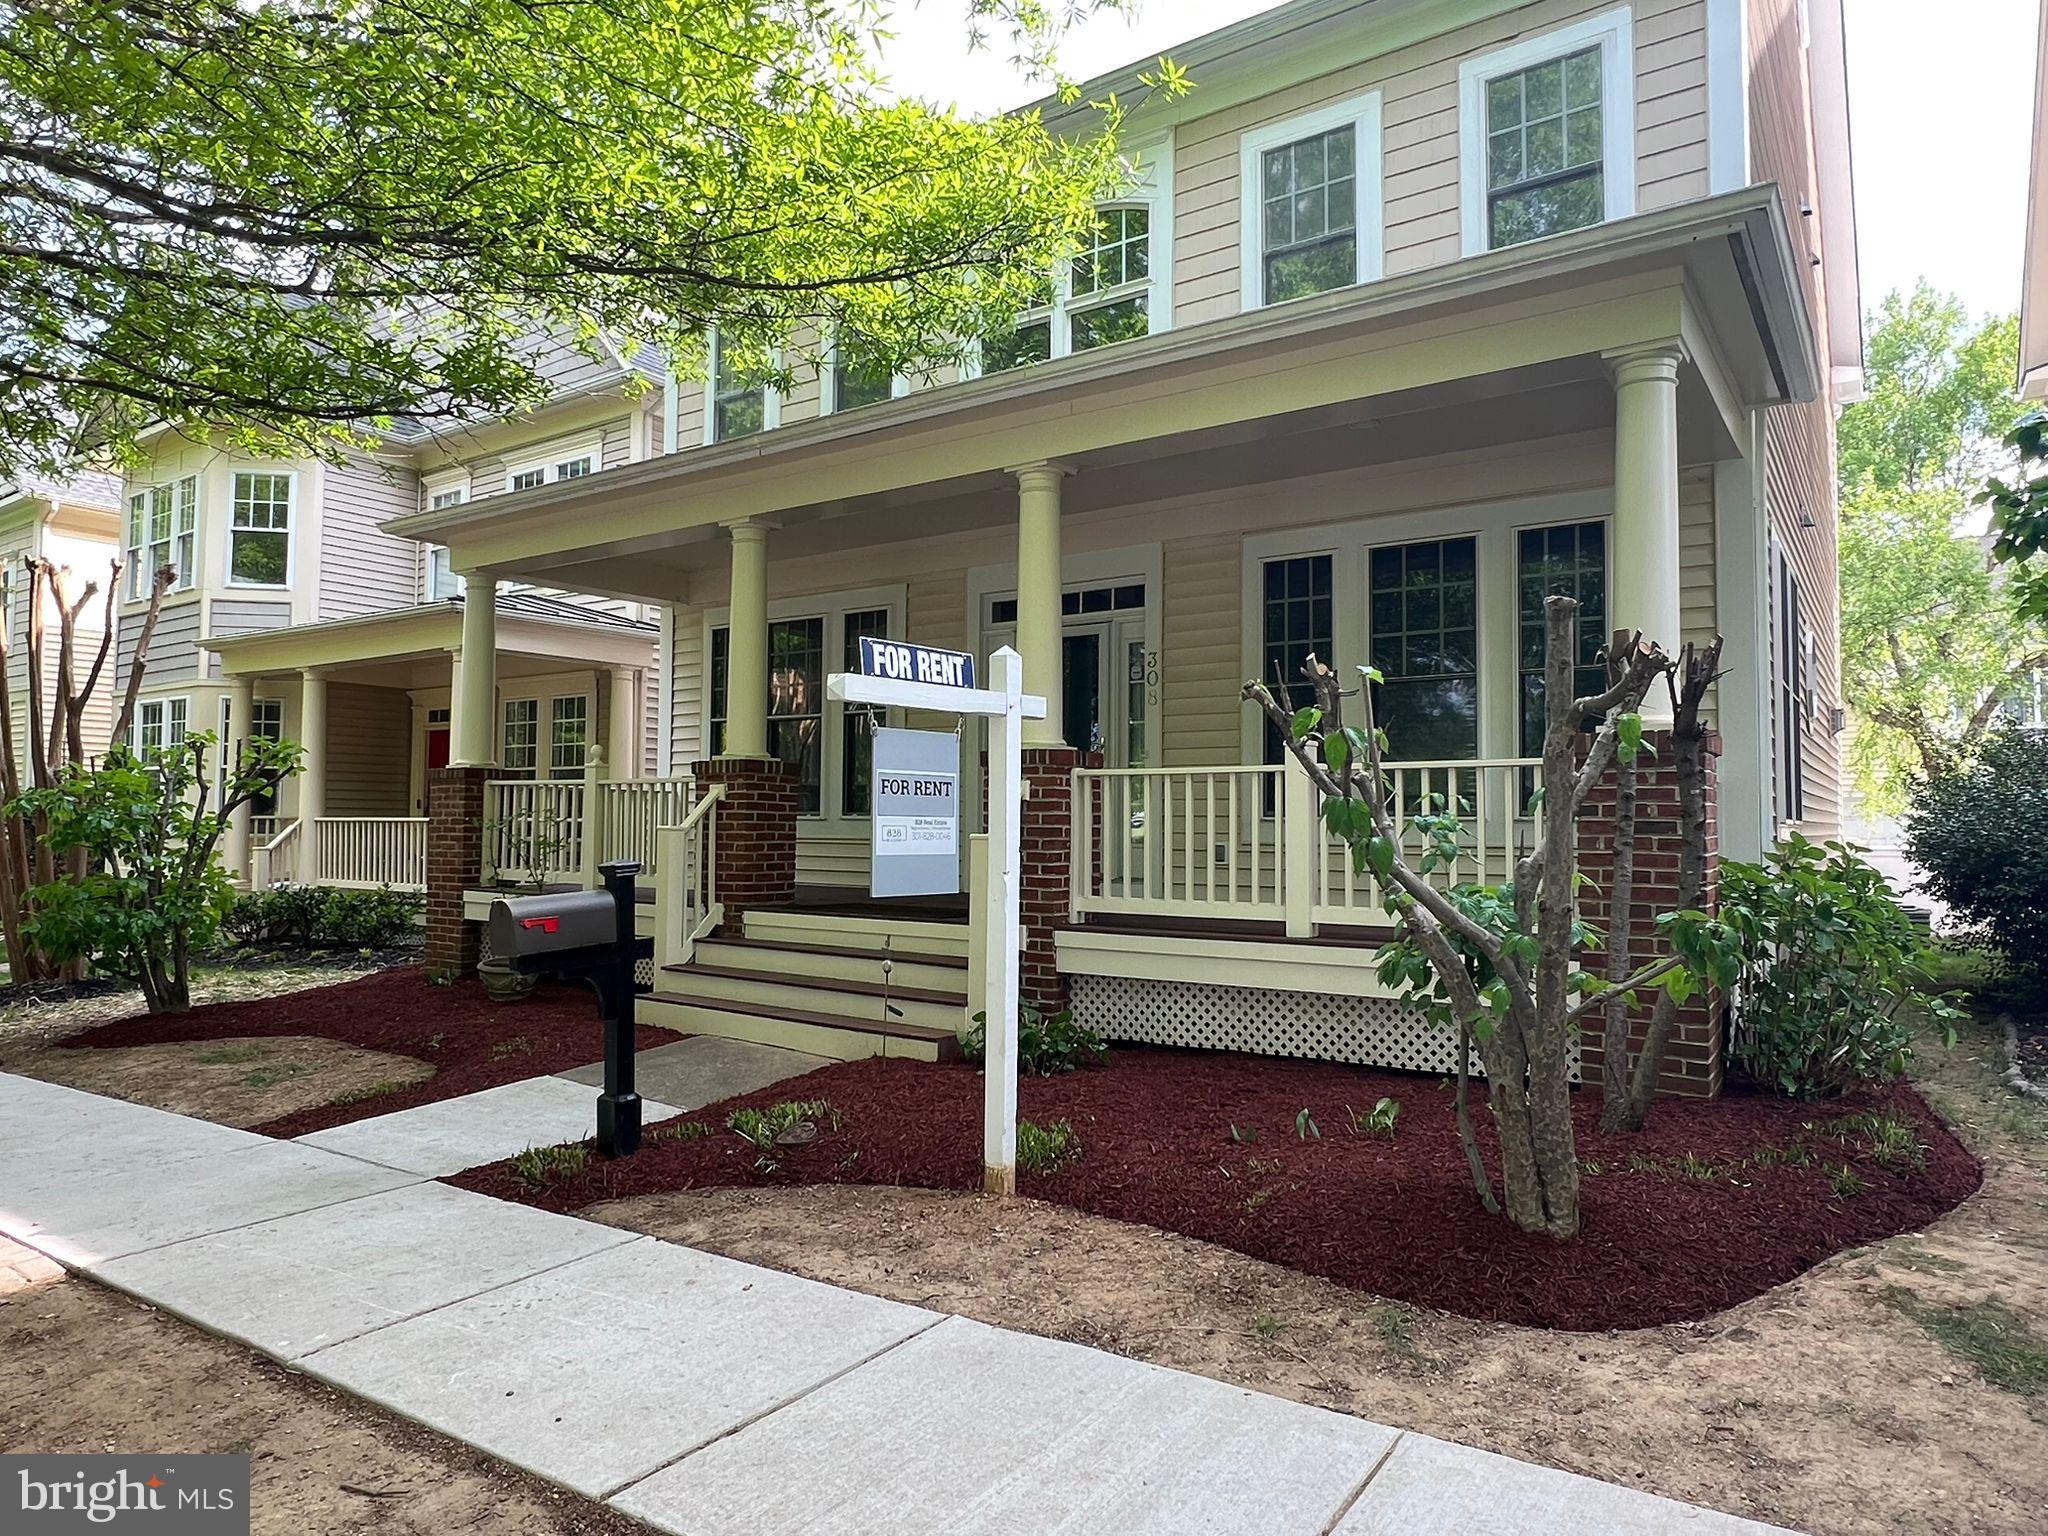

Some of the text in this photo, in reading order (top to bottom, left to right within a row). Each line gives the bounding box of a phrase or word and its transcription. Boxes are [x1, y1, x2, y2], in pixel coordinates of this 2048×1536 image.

[872, 643, 964, 686] FOR RENT
[1147, 651, 1159, 706] 308
[880, 778, 952, 797] FOR RENT
[886, 828, 902, 838] 828
